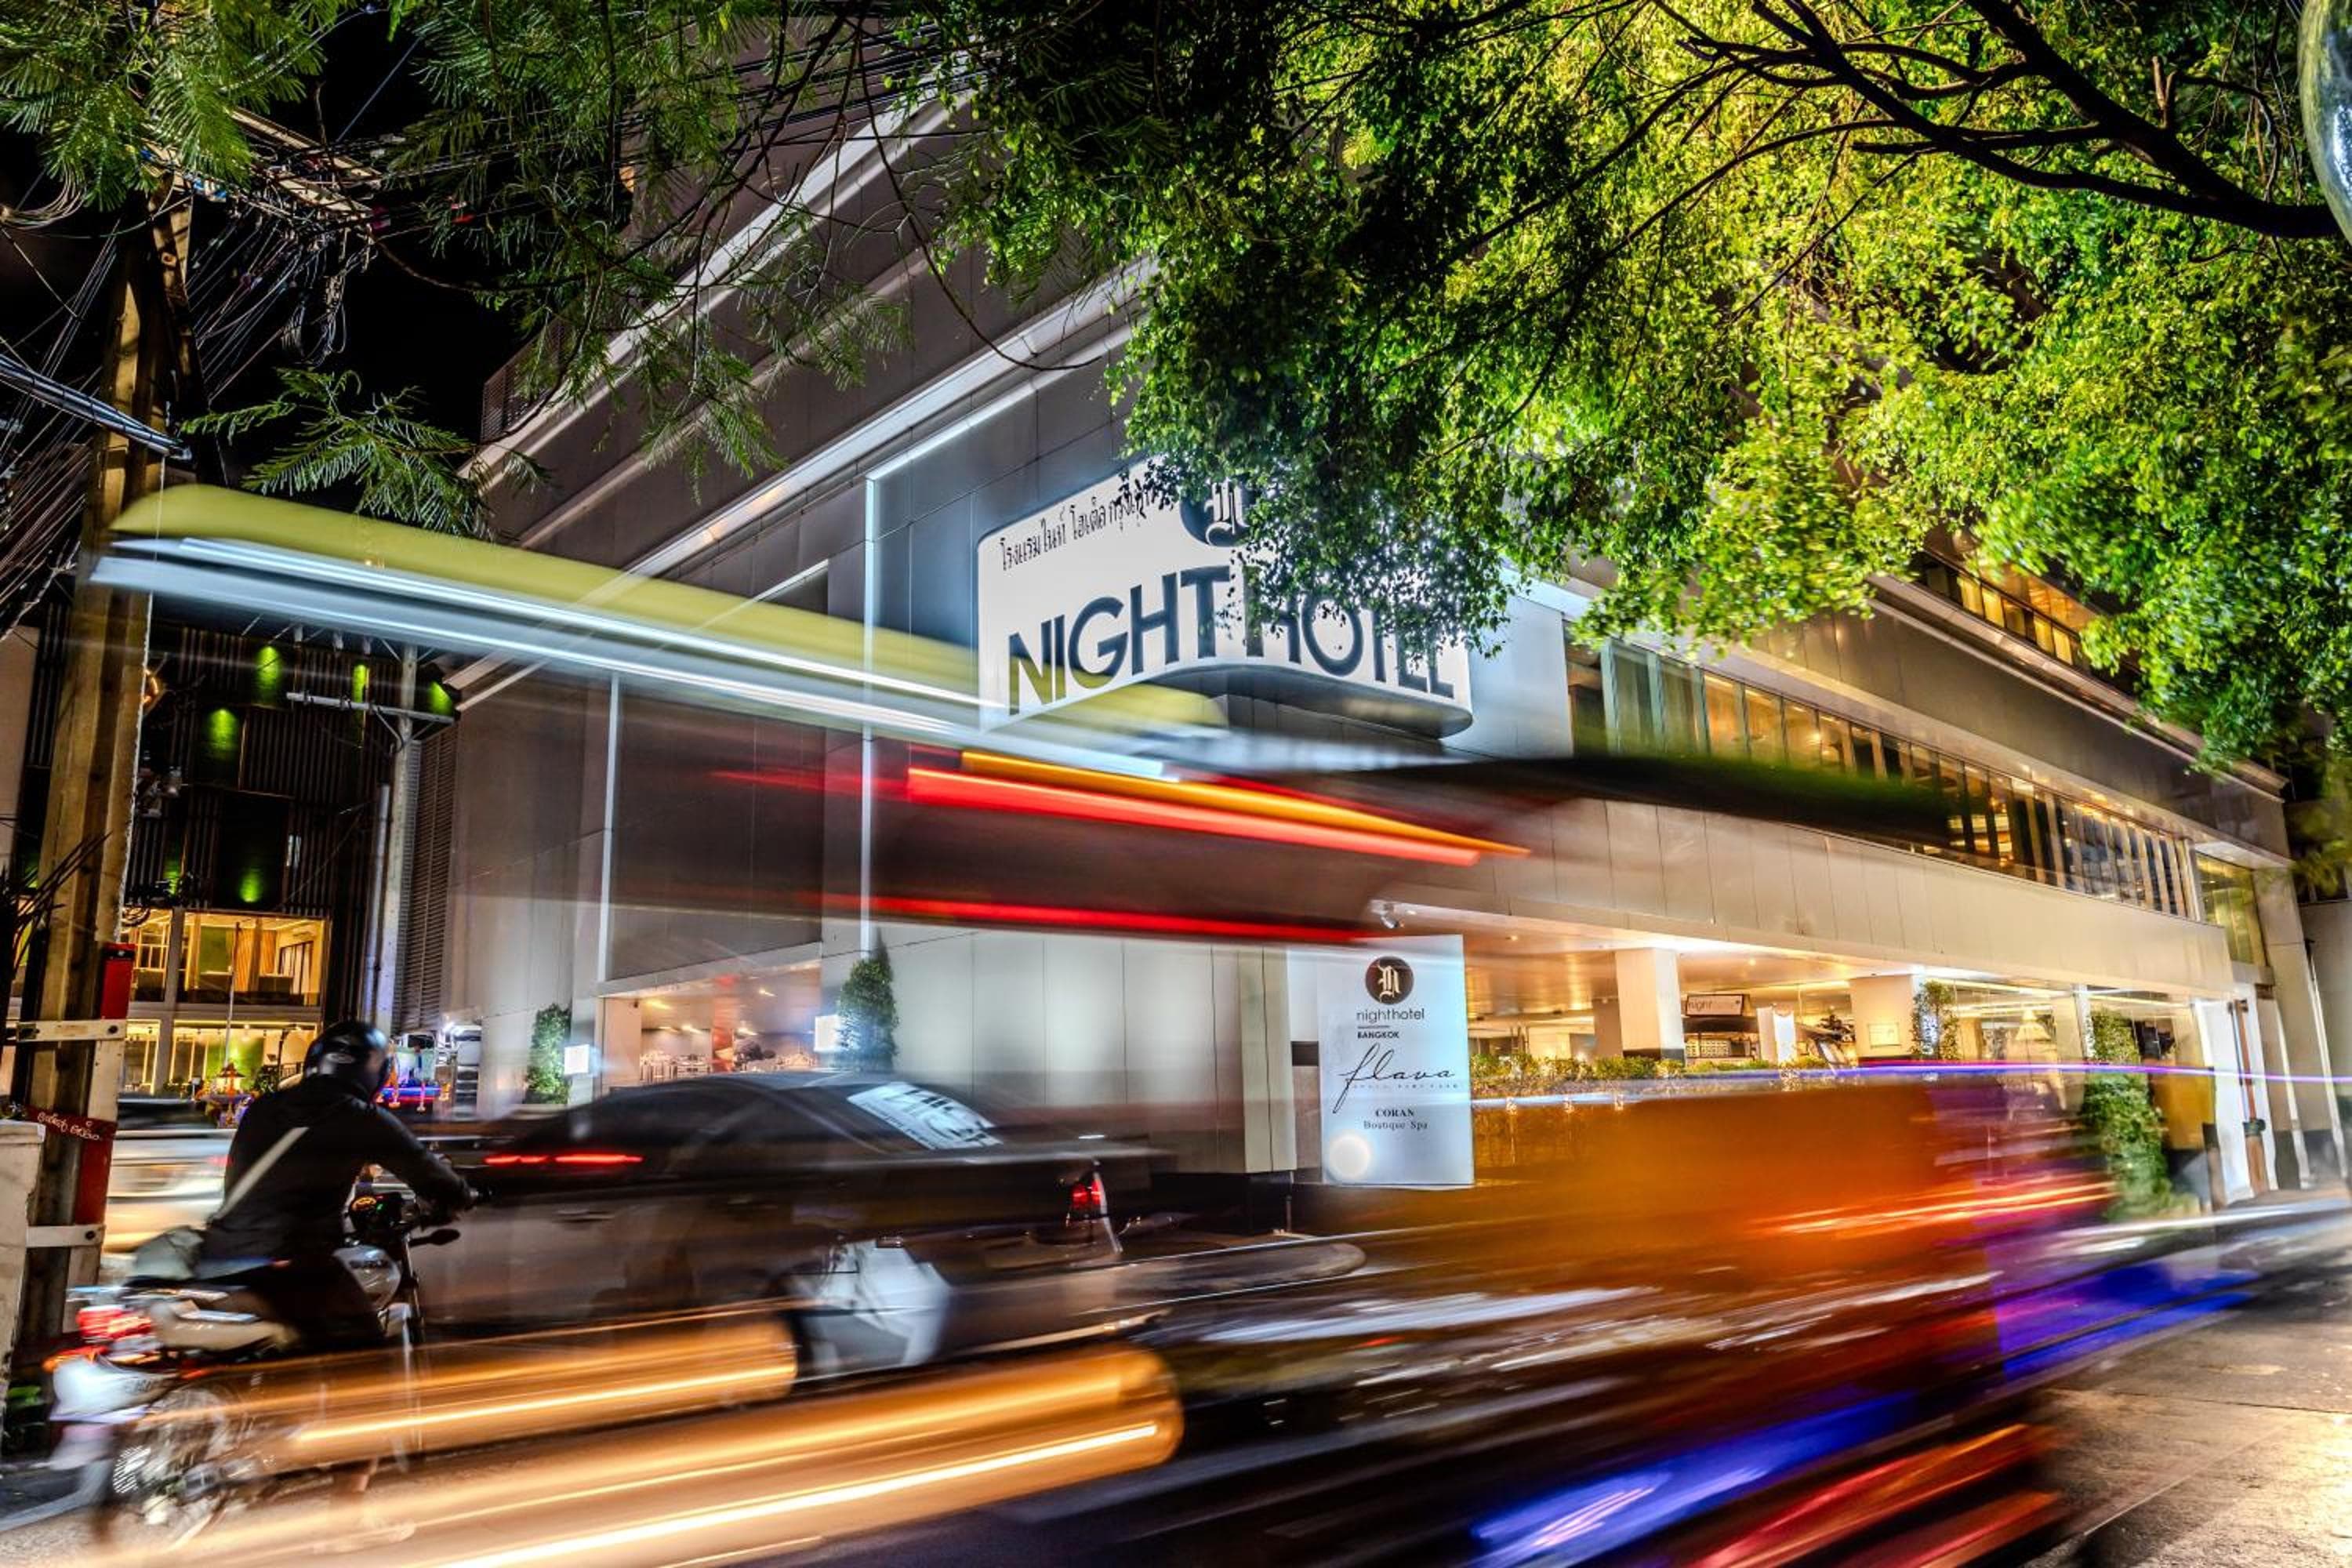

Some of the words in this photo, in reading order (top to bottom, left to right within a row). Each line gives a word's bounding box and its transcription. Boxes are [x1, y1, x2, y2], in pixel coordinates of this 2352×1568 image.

[1008, 565, 1230, 716] NIGHT
[1356, 1007, 1425, 1023] nighthotel
[1375, 1109, 1415, 1117] CORAN
[1410, 1120, 1428, 1131] Spa
